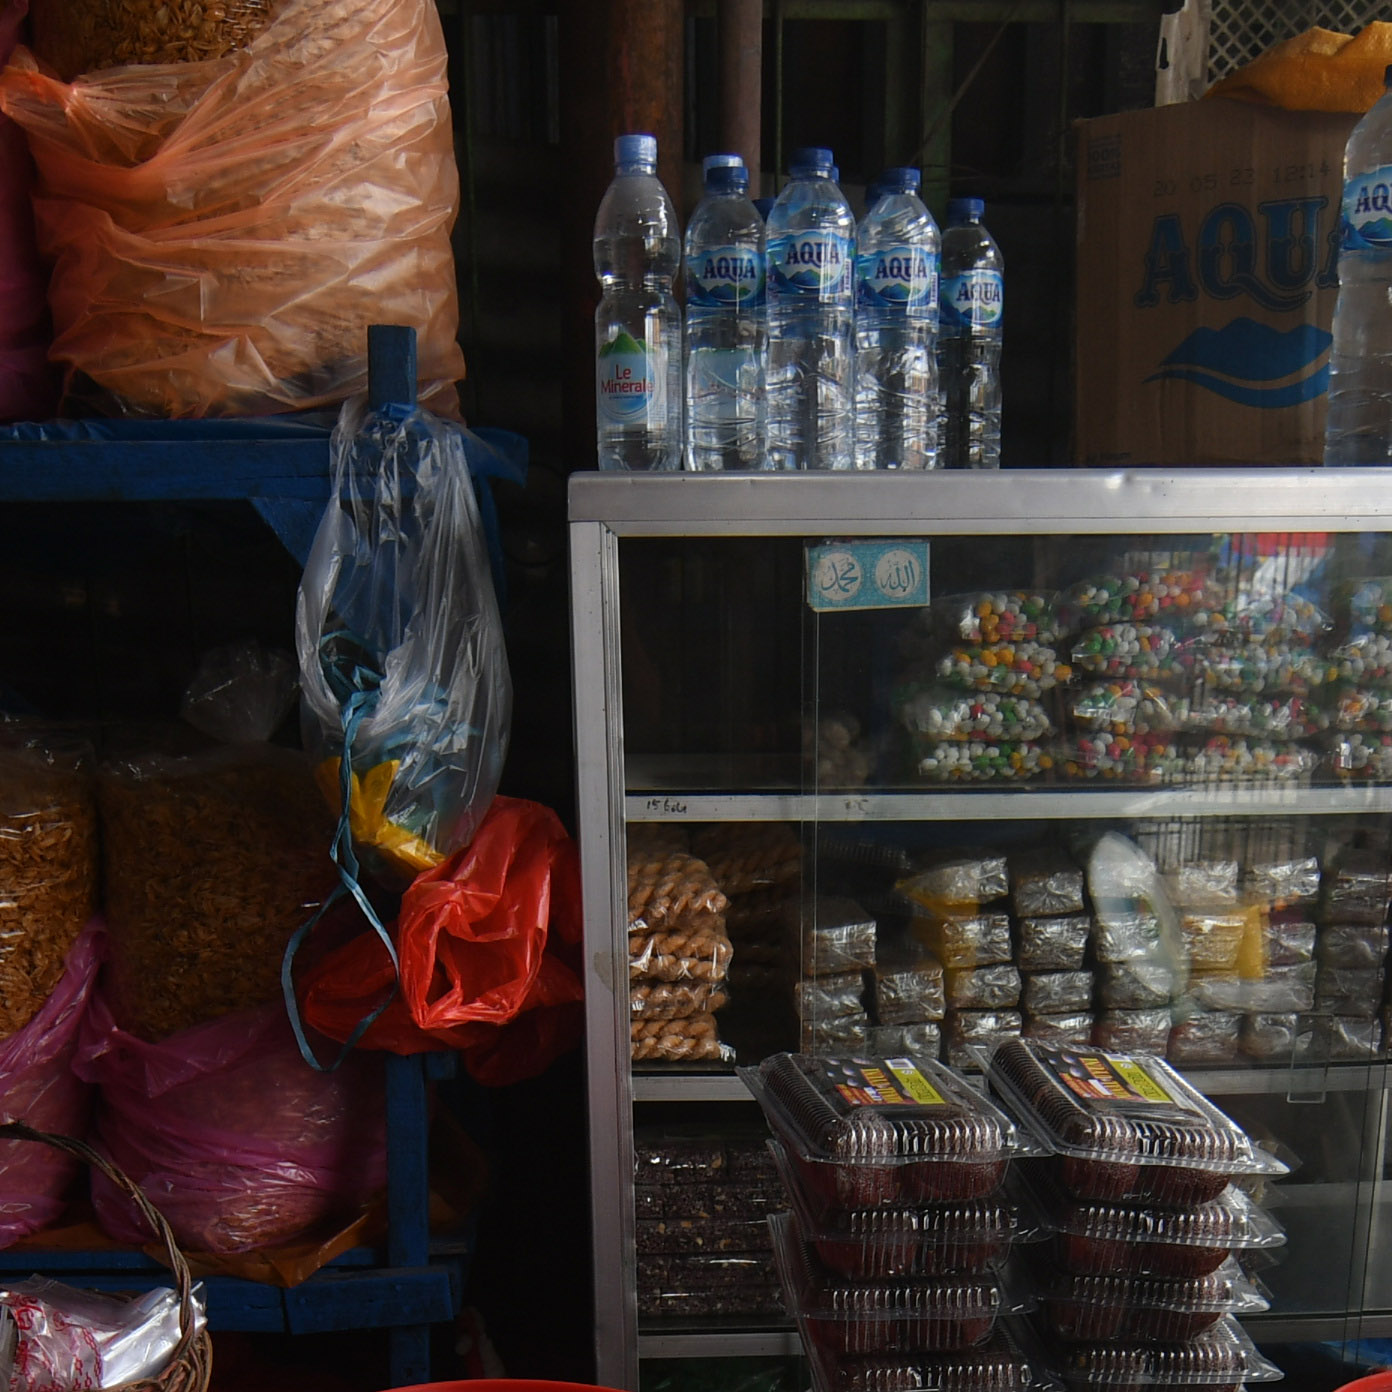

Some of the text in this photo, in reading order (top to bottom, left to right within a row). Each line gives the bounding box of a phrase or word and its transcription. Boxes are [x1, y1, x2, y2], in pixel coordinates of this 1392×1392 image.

[785, 241, 841, 268] AQUA
[702, 256, 757, 283] AQUA
[874, 256, 929, 282] AQUA
[956, 281, 1001, 305] AQUA
[615, 363, 632, 380] Le
[601, 376, 655, 394] Minerale
[820, 557, 916, 594] الله محمد
